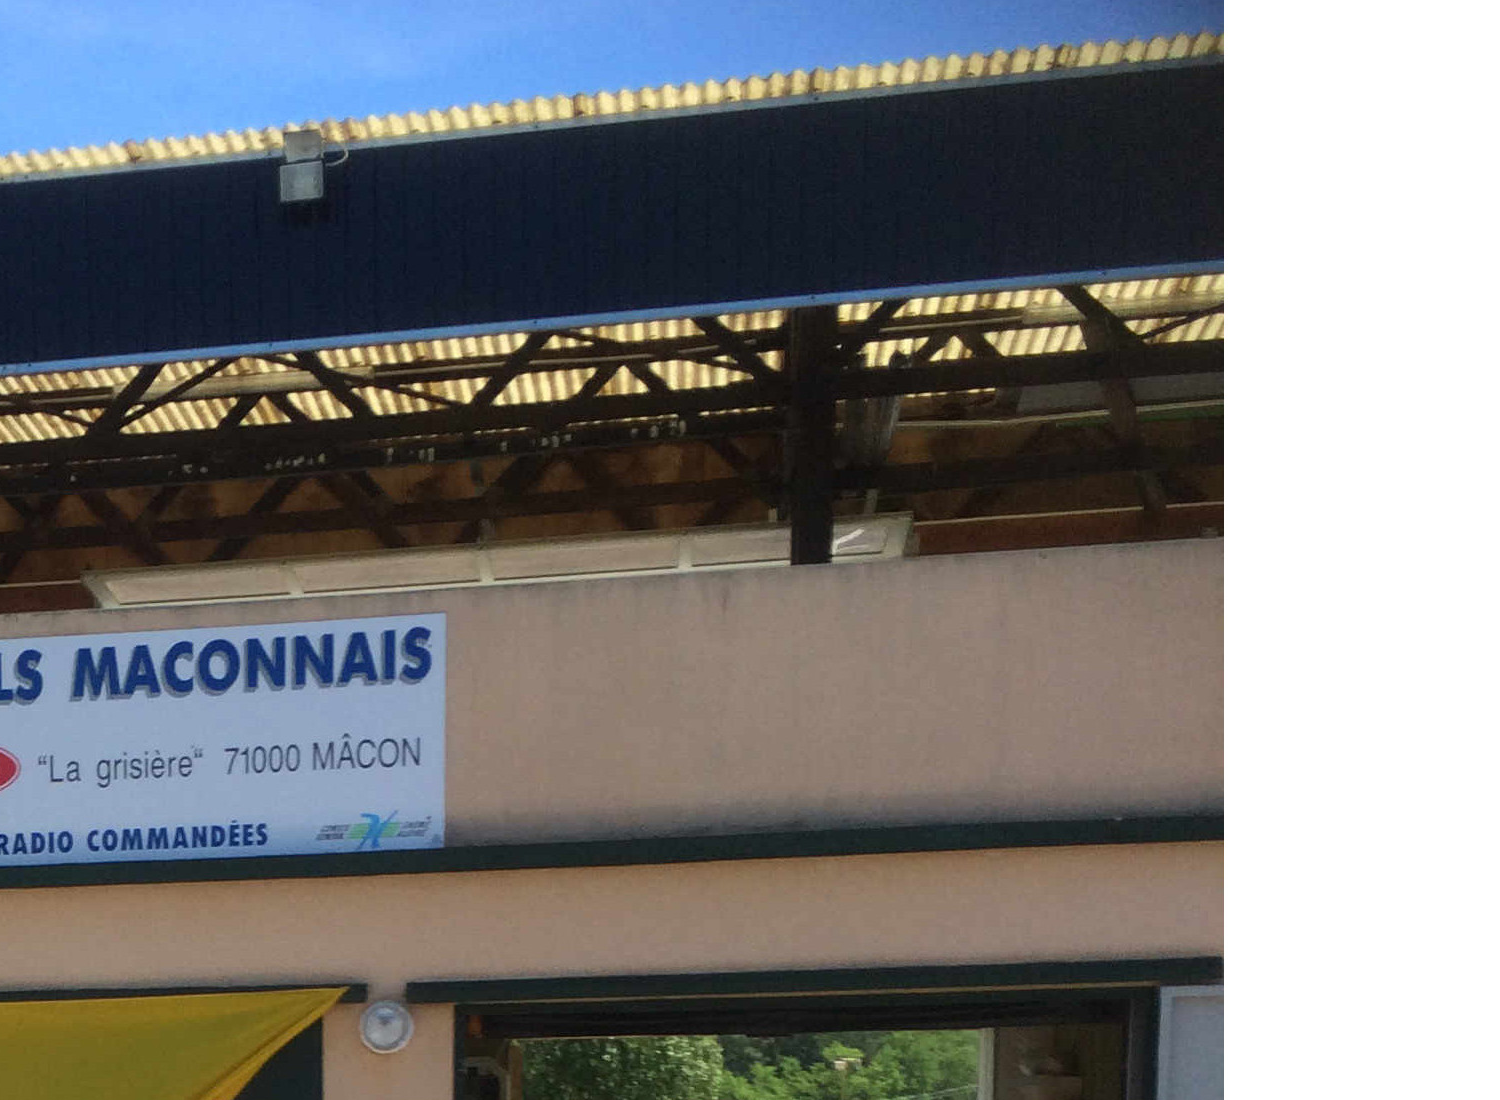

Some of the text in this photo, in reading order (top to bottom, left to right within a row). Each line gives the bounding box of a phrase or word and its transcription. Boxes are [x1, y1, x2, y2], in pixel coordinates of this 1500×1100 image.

[70, 626, 433, 701] MACONNAIS
[224, 743, 300, 776] 71000
[312, 733, 422, 771] MÂCON
[87, 820, 269, 852] COMMANDÉES
